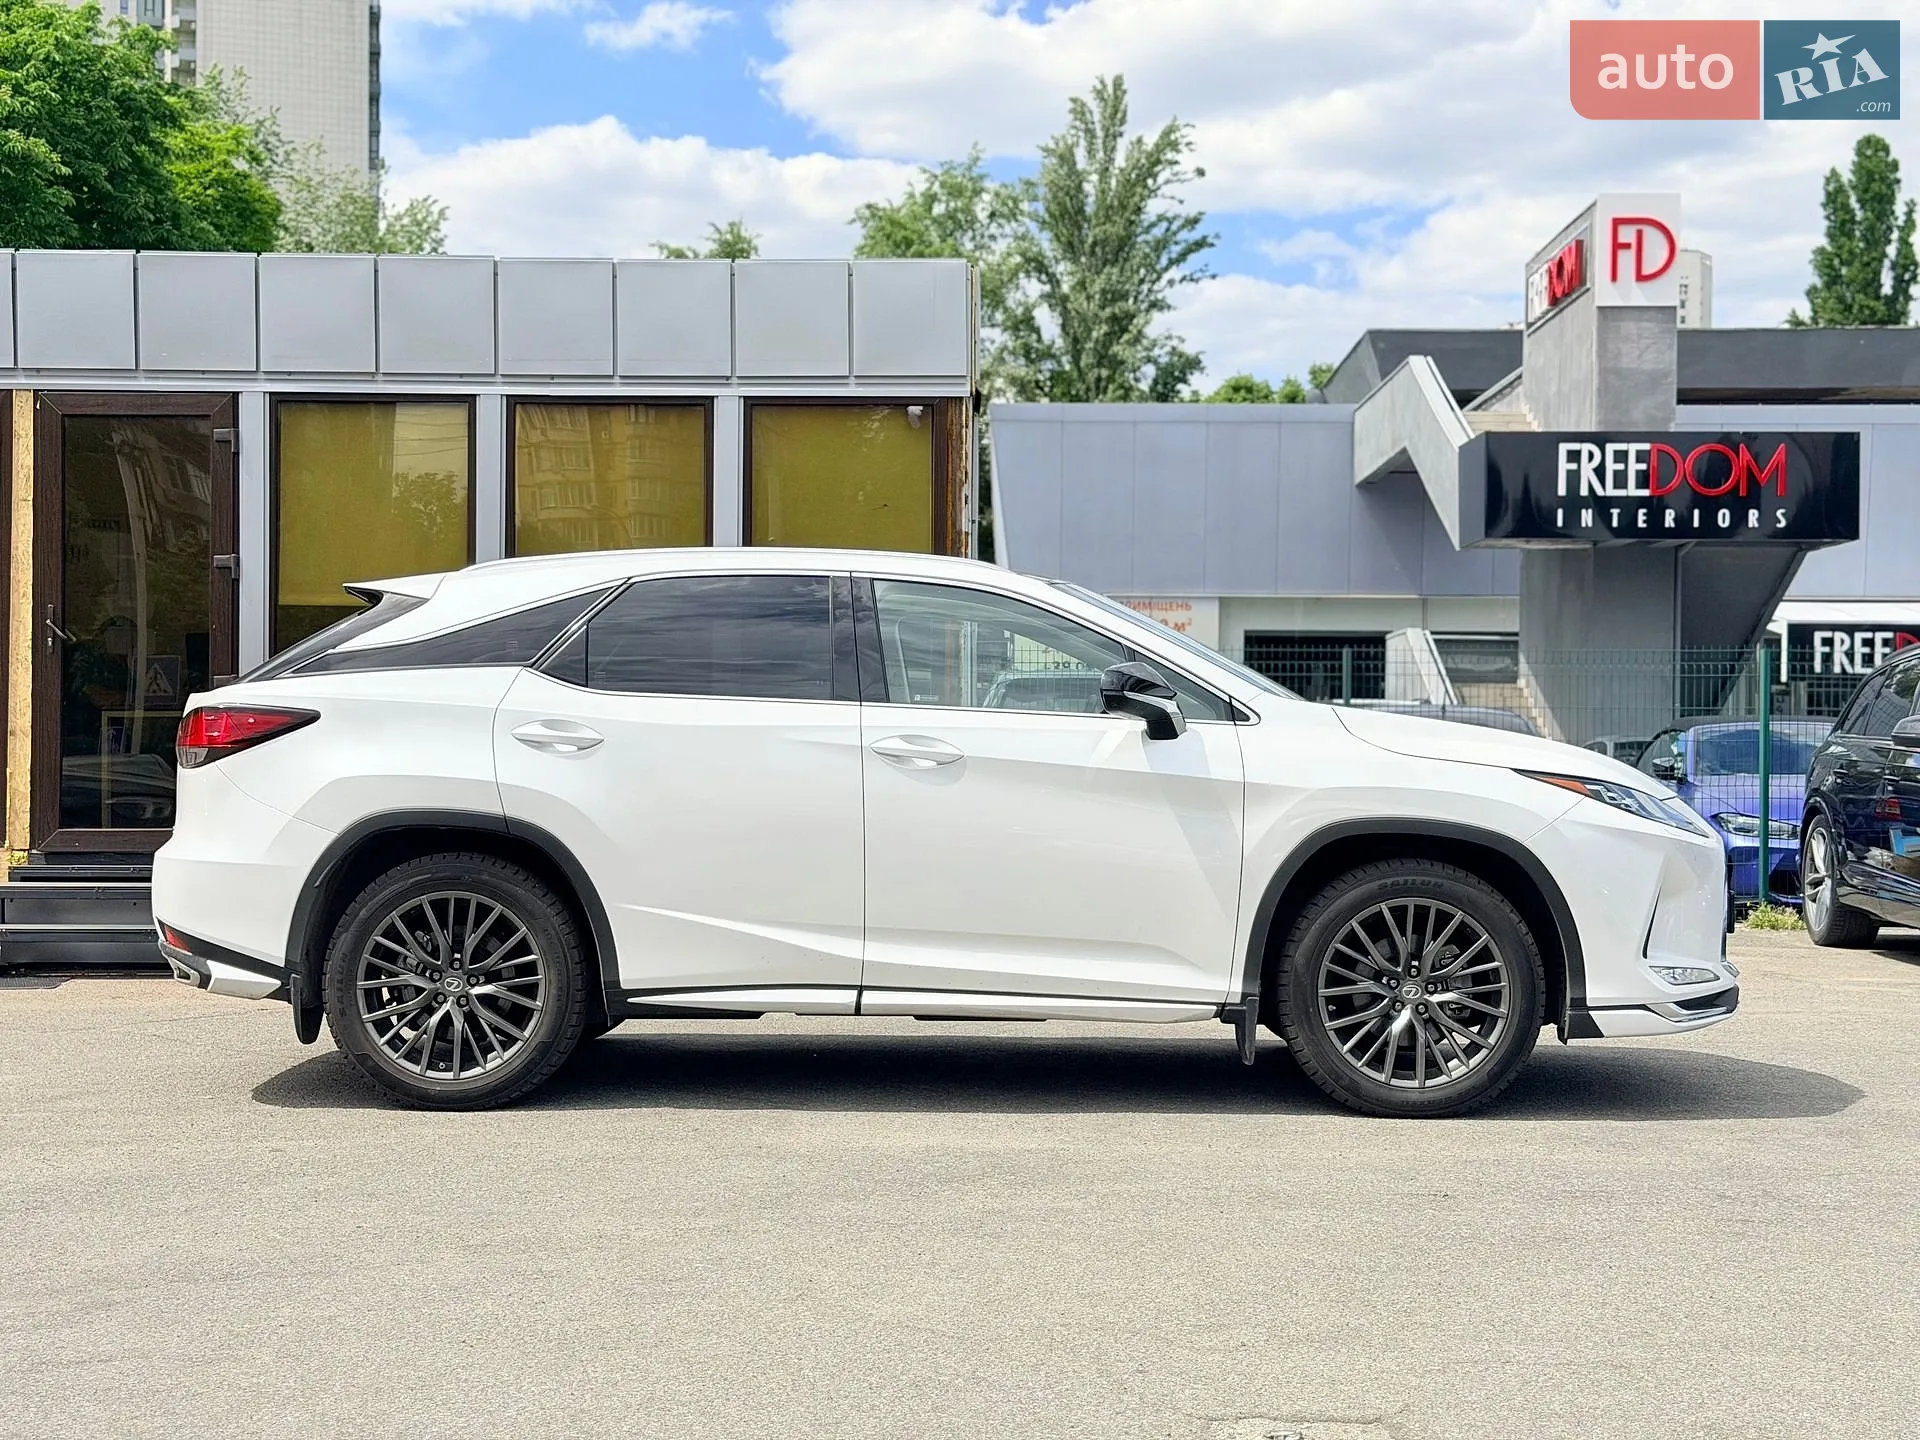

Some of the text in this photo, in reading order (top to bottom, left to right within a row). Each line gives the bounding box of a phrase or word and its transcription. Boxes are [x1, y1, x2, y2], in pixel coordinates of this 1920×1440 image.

[1610, 217, 1676, 283] FD
[1557, 442, 1787, 497] FREEDOM
[1556, 508, 1787, 528] INTERIORS
